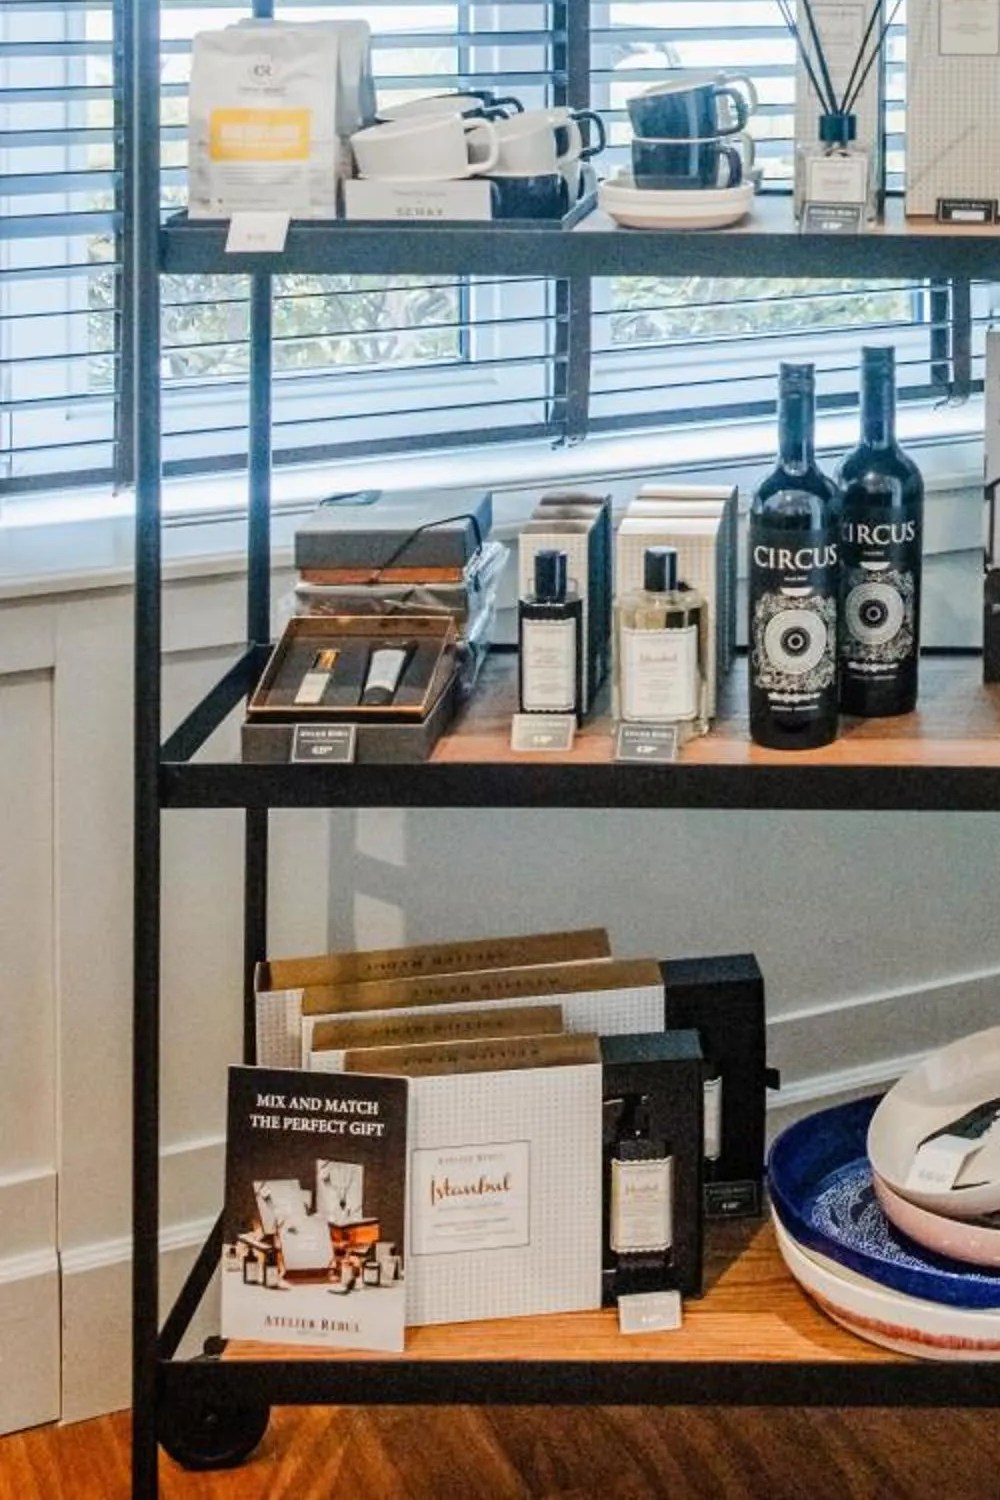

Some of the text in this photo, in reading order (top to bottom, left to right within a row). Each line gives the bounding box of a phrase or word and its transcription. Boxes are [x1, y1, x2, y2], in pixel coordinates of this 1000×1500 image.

[841, 520, 915, 545] CIRCUS
[753, 543, 837, 571] CIRCUS
[256, 1093, 379, 1115] MIX AND MATCH
[249, 1113, 385, 1137] THE PERFECT GIFT
